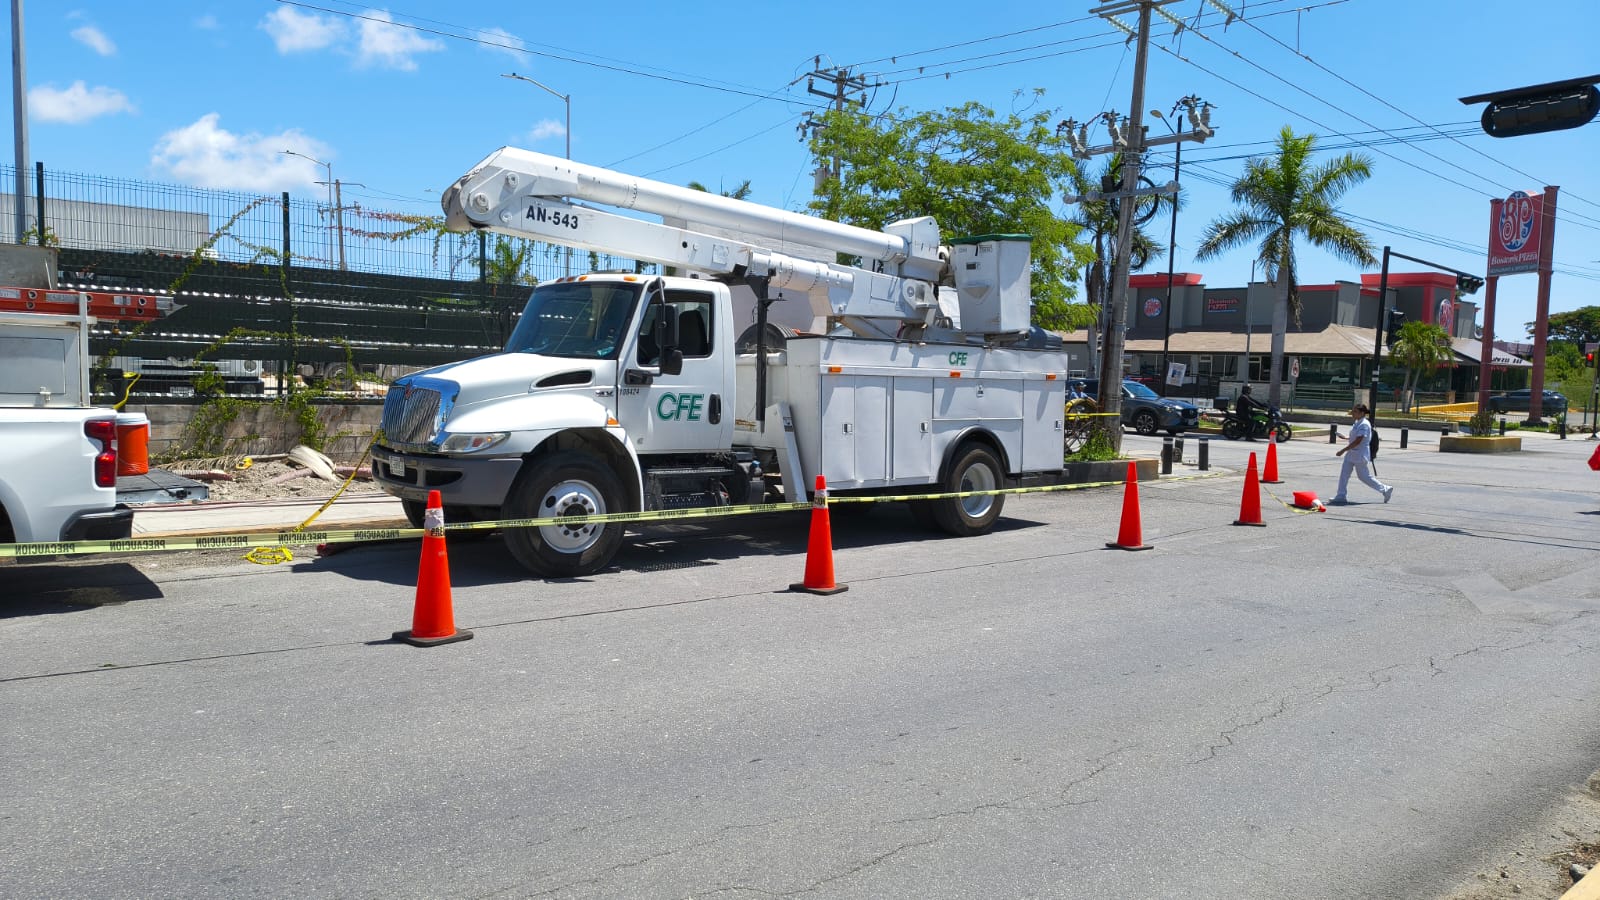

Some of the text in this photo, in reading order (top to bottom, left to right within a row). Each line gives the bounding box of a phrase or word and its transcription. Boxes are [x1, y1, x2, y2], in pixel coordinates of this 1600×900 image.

[526, 205, 578, 229] AN-543
[949, 351, 967, 366] CFE
[657, 392, 704, 421] CFE
